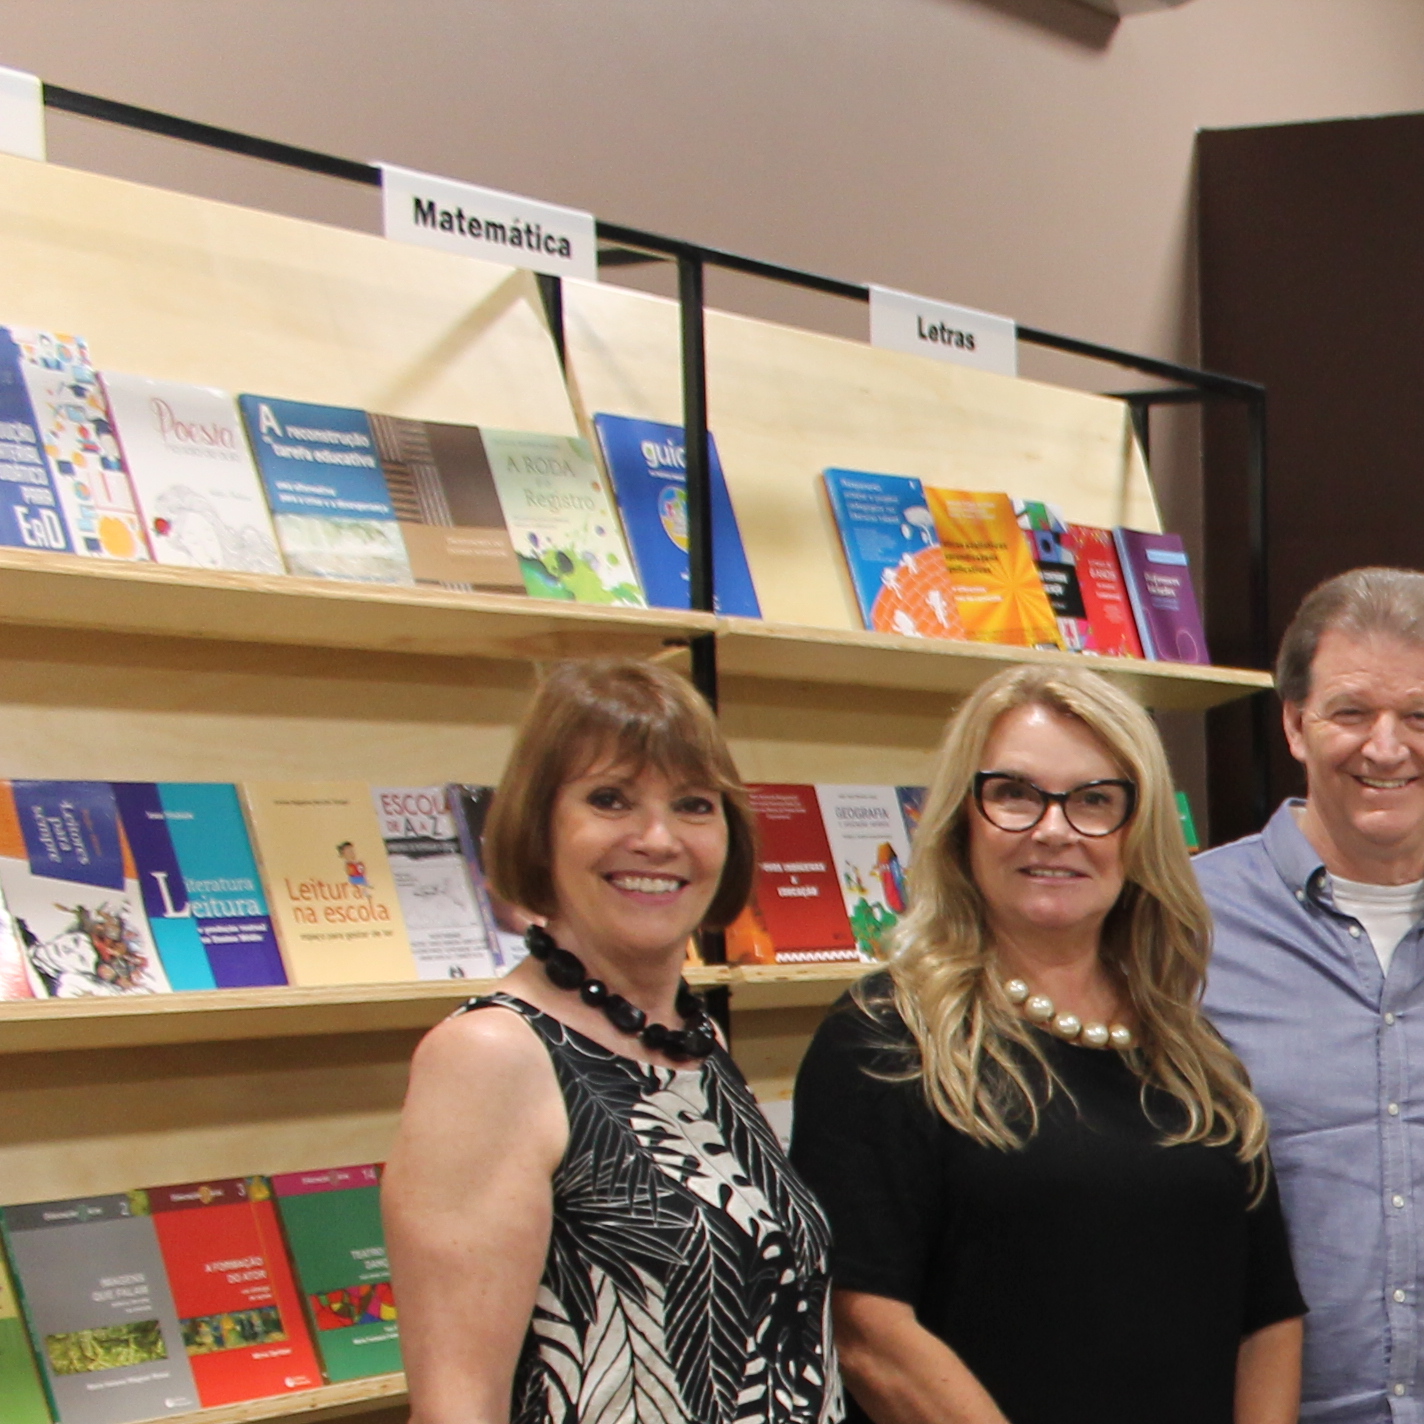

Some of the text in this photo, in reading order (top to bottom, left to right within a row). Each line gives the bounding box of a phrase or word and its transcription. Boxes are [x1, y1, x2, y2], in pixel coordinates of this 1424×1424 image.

[412, 196, 571, 258] Matemática
[916, 314, 976, 350] Letras
[152, 397, 236, 449] Poesia
[259, 403, 370, 448] A reconstrução
[271, 443, 314, 462] tarefa
[312, 449, 377, 469] educativa
[507, 456, 574, 478] A RODA
[525, 489, 596, 512] Registro
[380, 794, 452, 816] ESCOL
[835, 807, 889, 820] GEOGRAFIA
[61, 800, 90, 865] Leitores
[404, 817, 419, 837] A
[430, 816, 442, 836] Z
[284, 877, 363, 901] Leitura
[293, 898, 390, 924] na escola
[236, 1184, 246, 1197] 3
[120, 1202, 129, 1215] 2
[213, 1256, 263, 1271] FORMAÇÃO
[242, 1270, 267, 1282] ATOR
